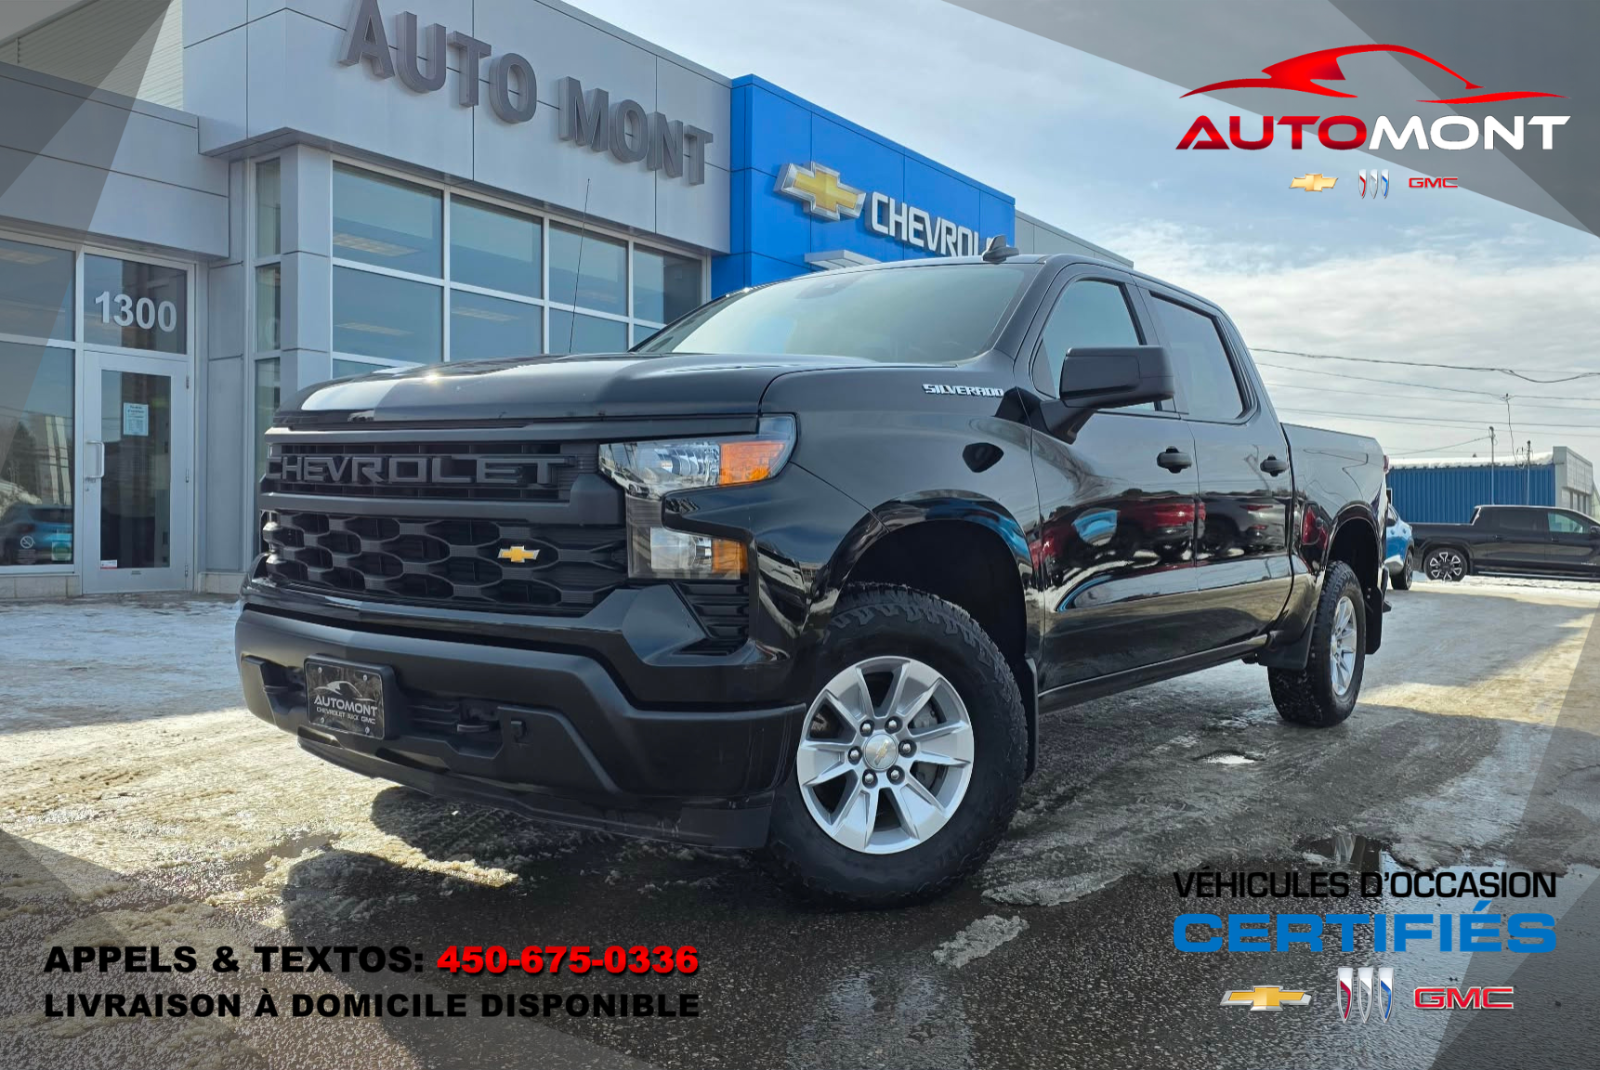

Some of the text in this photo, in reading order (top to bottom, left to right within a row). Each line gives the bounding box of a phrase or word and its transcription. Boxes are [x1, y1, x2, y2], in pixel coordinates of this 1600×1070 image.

[338, 0, 714, 186] AUTO MONT
[868, 191, 1011, 257] CHEVROL
[95, 291, 177, 332] 1300
[922, 383, 1004, 397] SILVERADO
[265, 455, 568, 484] CHEVROLET
[314, 695, 378, 717] AUTOMONT
